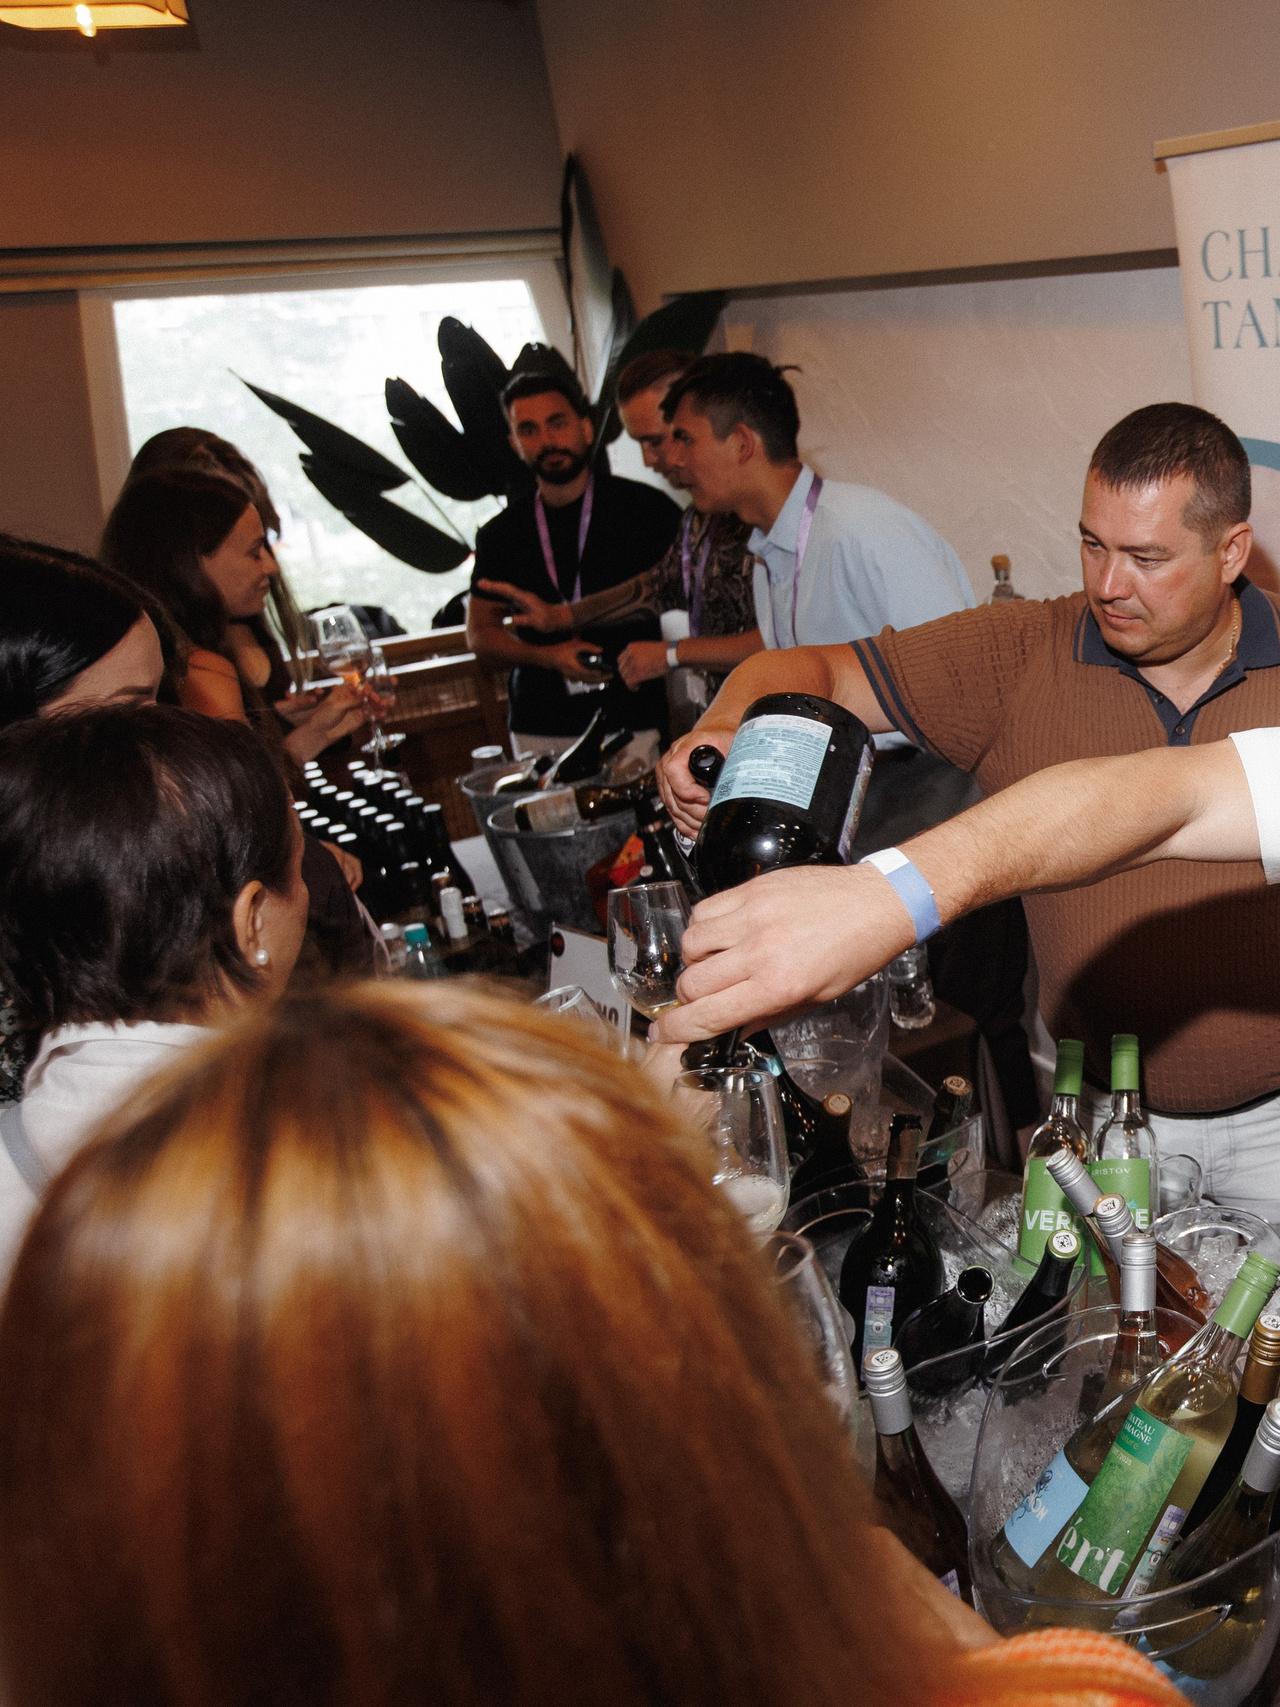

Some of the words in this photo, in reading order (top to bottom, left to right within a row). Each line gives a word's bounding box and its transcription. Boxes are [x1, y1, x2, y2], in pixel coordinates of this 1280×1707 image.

[1092, 1167, 1132, 1176] RISTOV
[1024, 1208, 1085, 1234] VERD
[1127, 1411, 1156, 1436] HATEAU
[1056, 1516, 1129, 1595] ért
